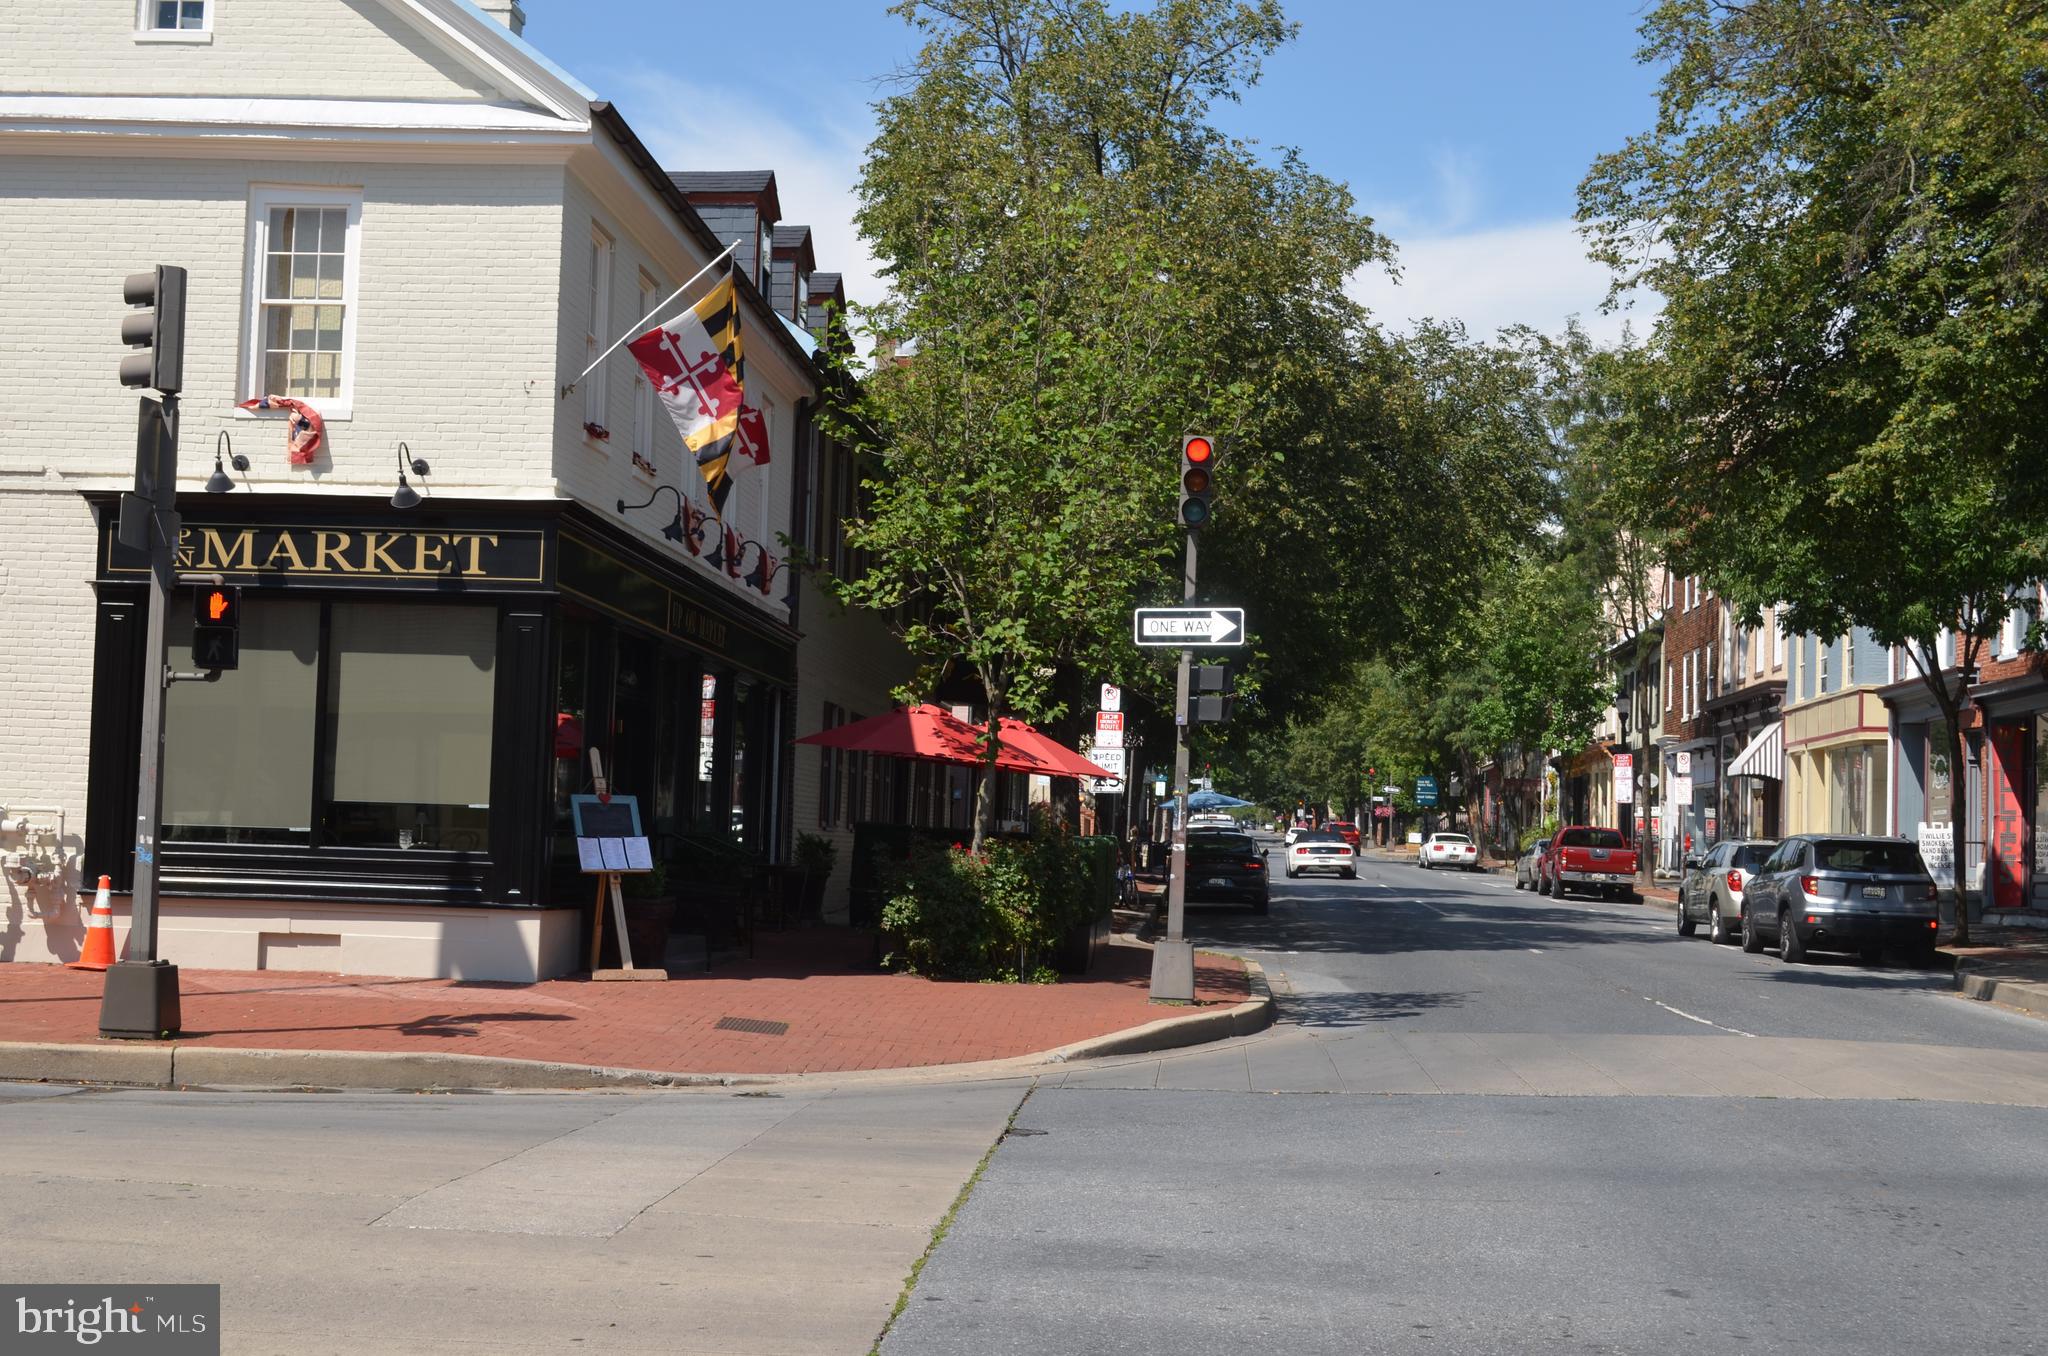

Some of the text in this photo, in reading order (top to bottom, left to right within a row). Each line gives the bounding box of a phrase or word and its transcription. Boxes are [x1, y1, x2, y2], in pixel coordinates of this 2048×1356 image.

[196, 527, 498, 576] MARKET
[1150, 620, 1212, 633] ONE WAY
[1100, 723, 1119, 731] ROUTE
[1093, 753, 1122, 761] SPEED
[1931, 854, 1948, 862] PIPES
